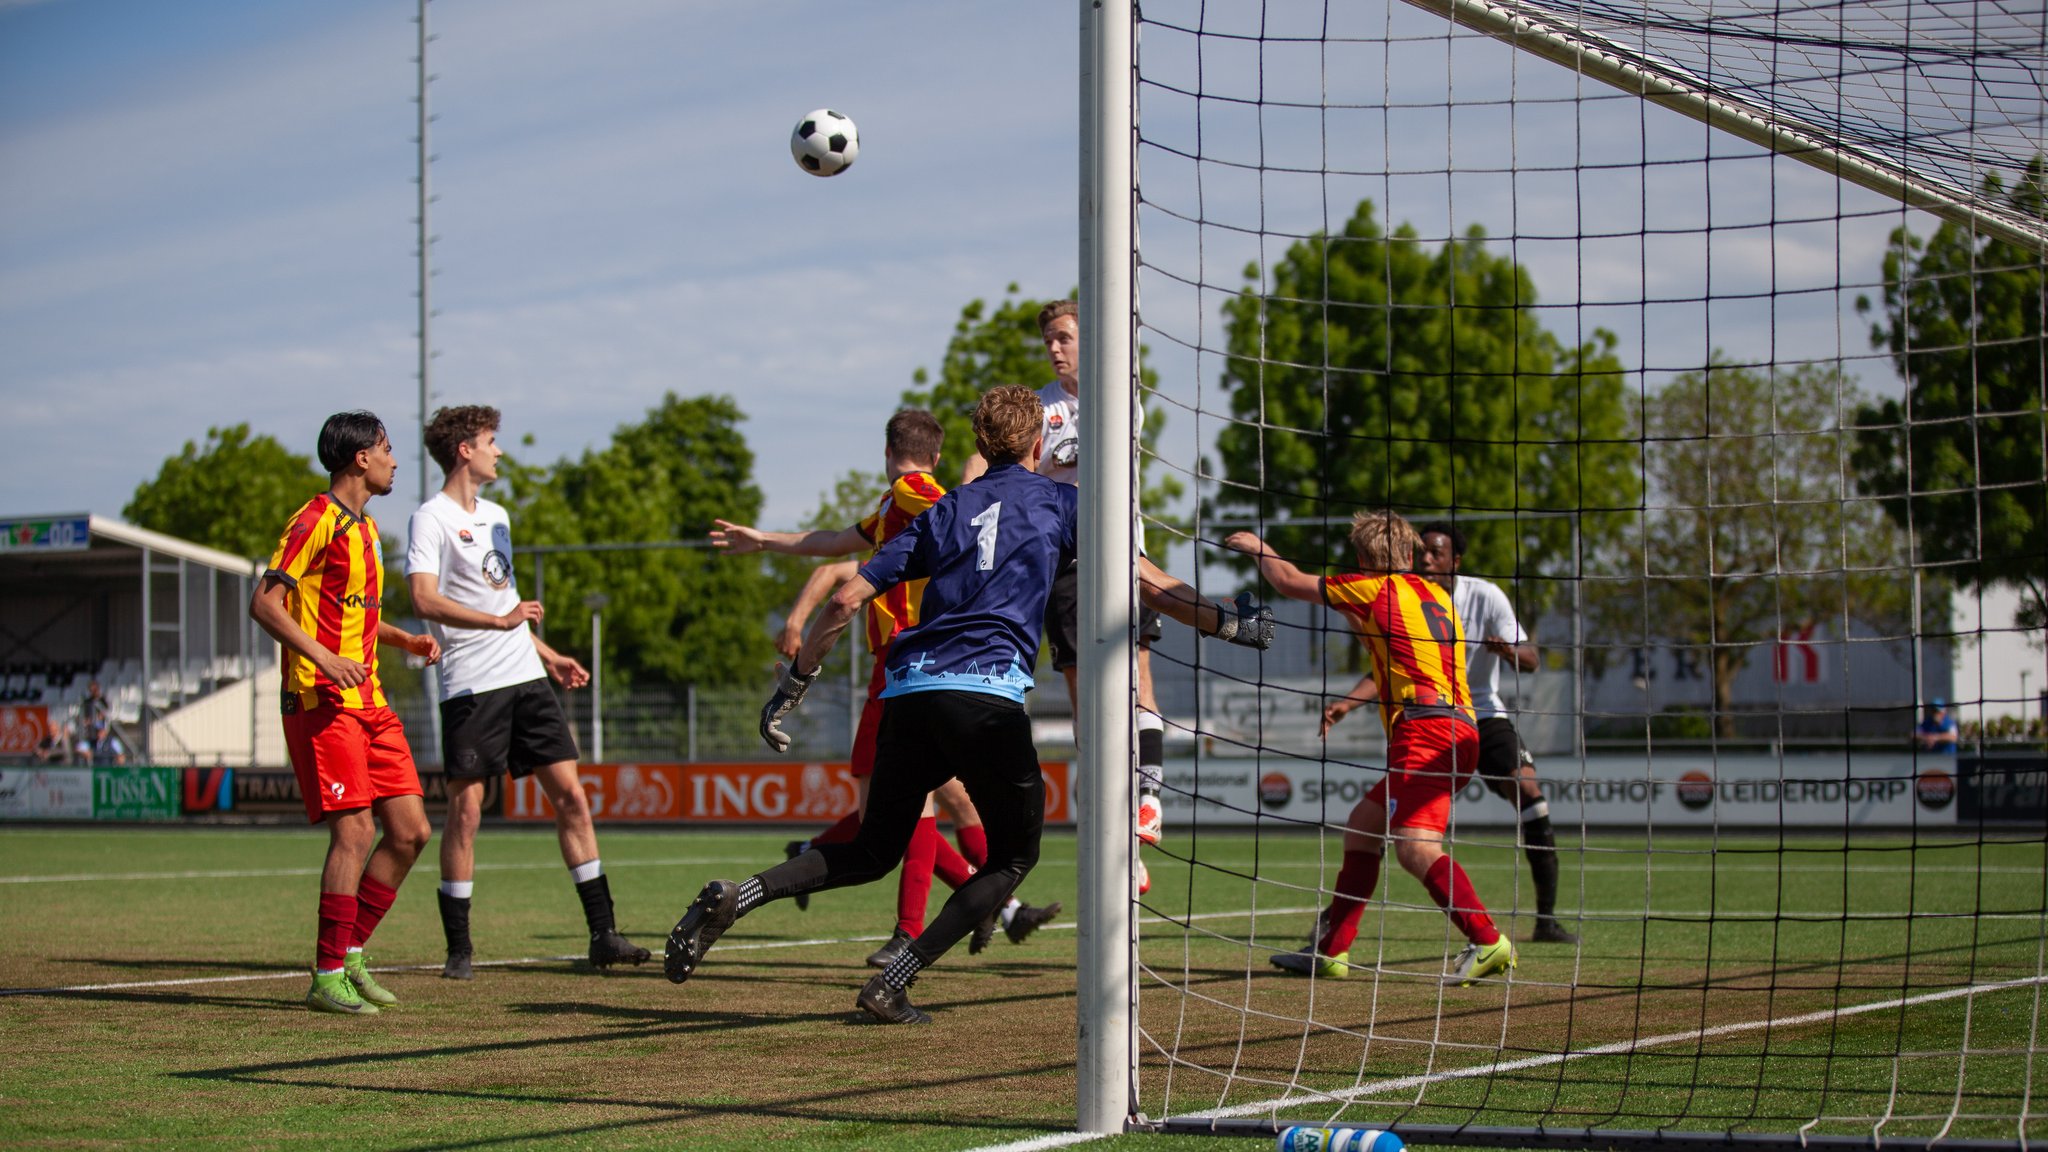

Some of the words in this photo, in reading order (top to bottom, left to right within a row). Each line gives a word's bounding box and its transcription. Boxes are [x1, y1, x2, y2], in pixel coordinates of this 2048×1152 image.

[971, 501, 1002, 571] 1
[1421, 601, 1454, 646] 6
[691, 773, 789, 817] ING
[1719, 780, 1906, 803] LEIDERDORP
